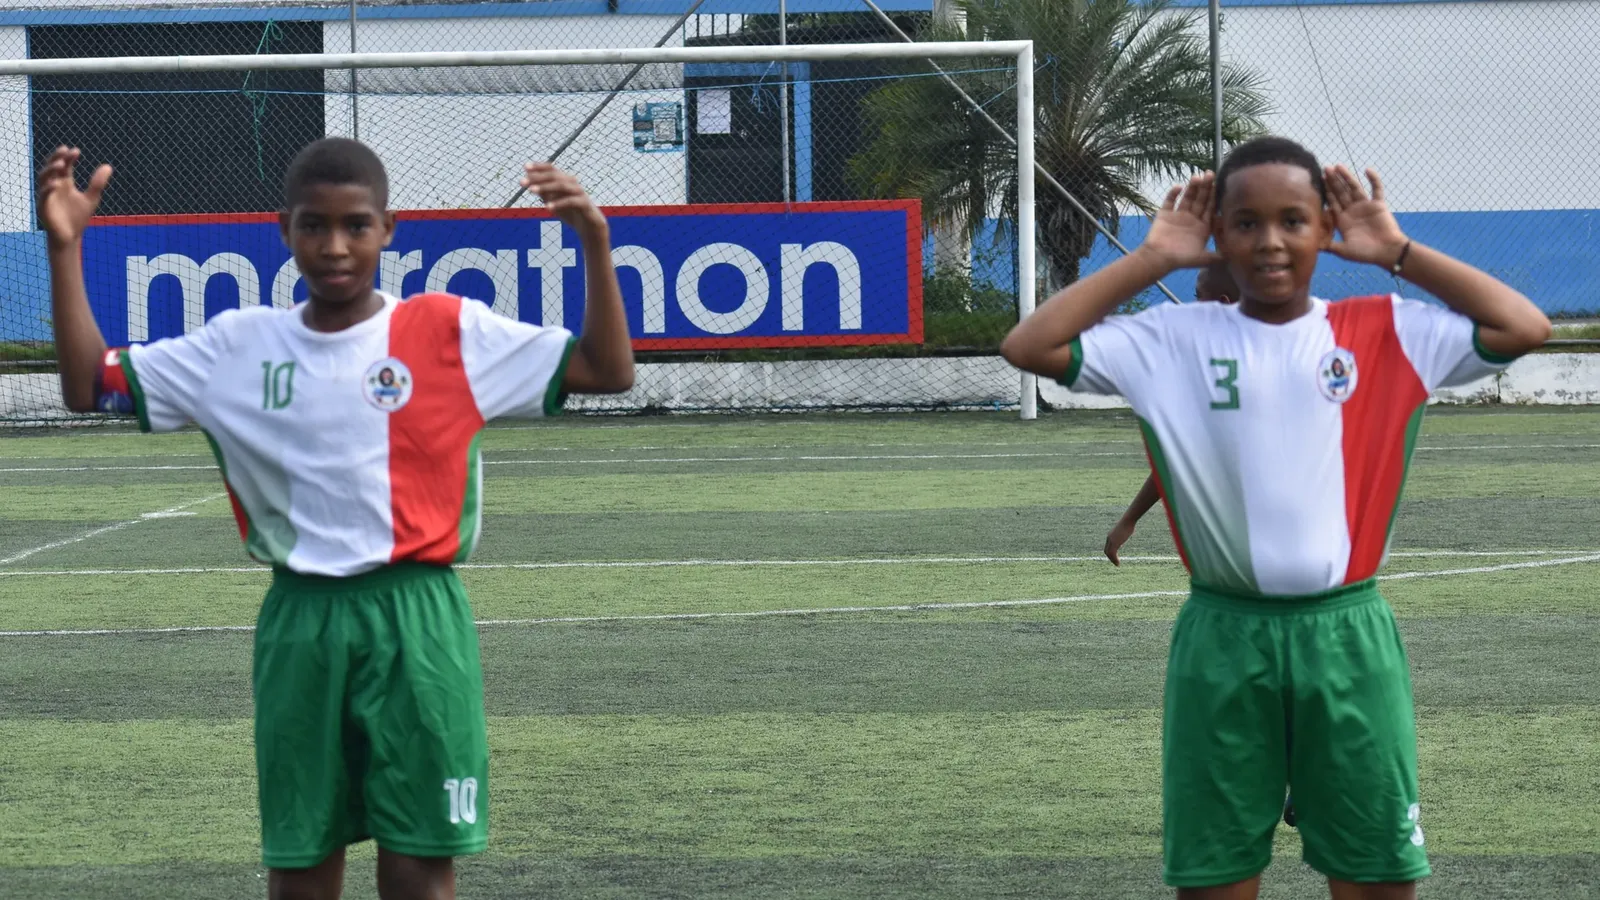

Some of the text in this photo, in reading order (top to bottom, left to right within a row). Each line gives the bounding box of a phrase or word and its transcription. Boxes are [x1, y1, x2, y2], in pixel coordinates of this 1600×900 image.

[261, 360, 296, 410] 10
[1209, 357, 1241, 411] 3
[443, 777, 478, 824] 10
